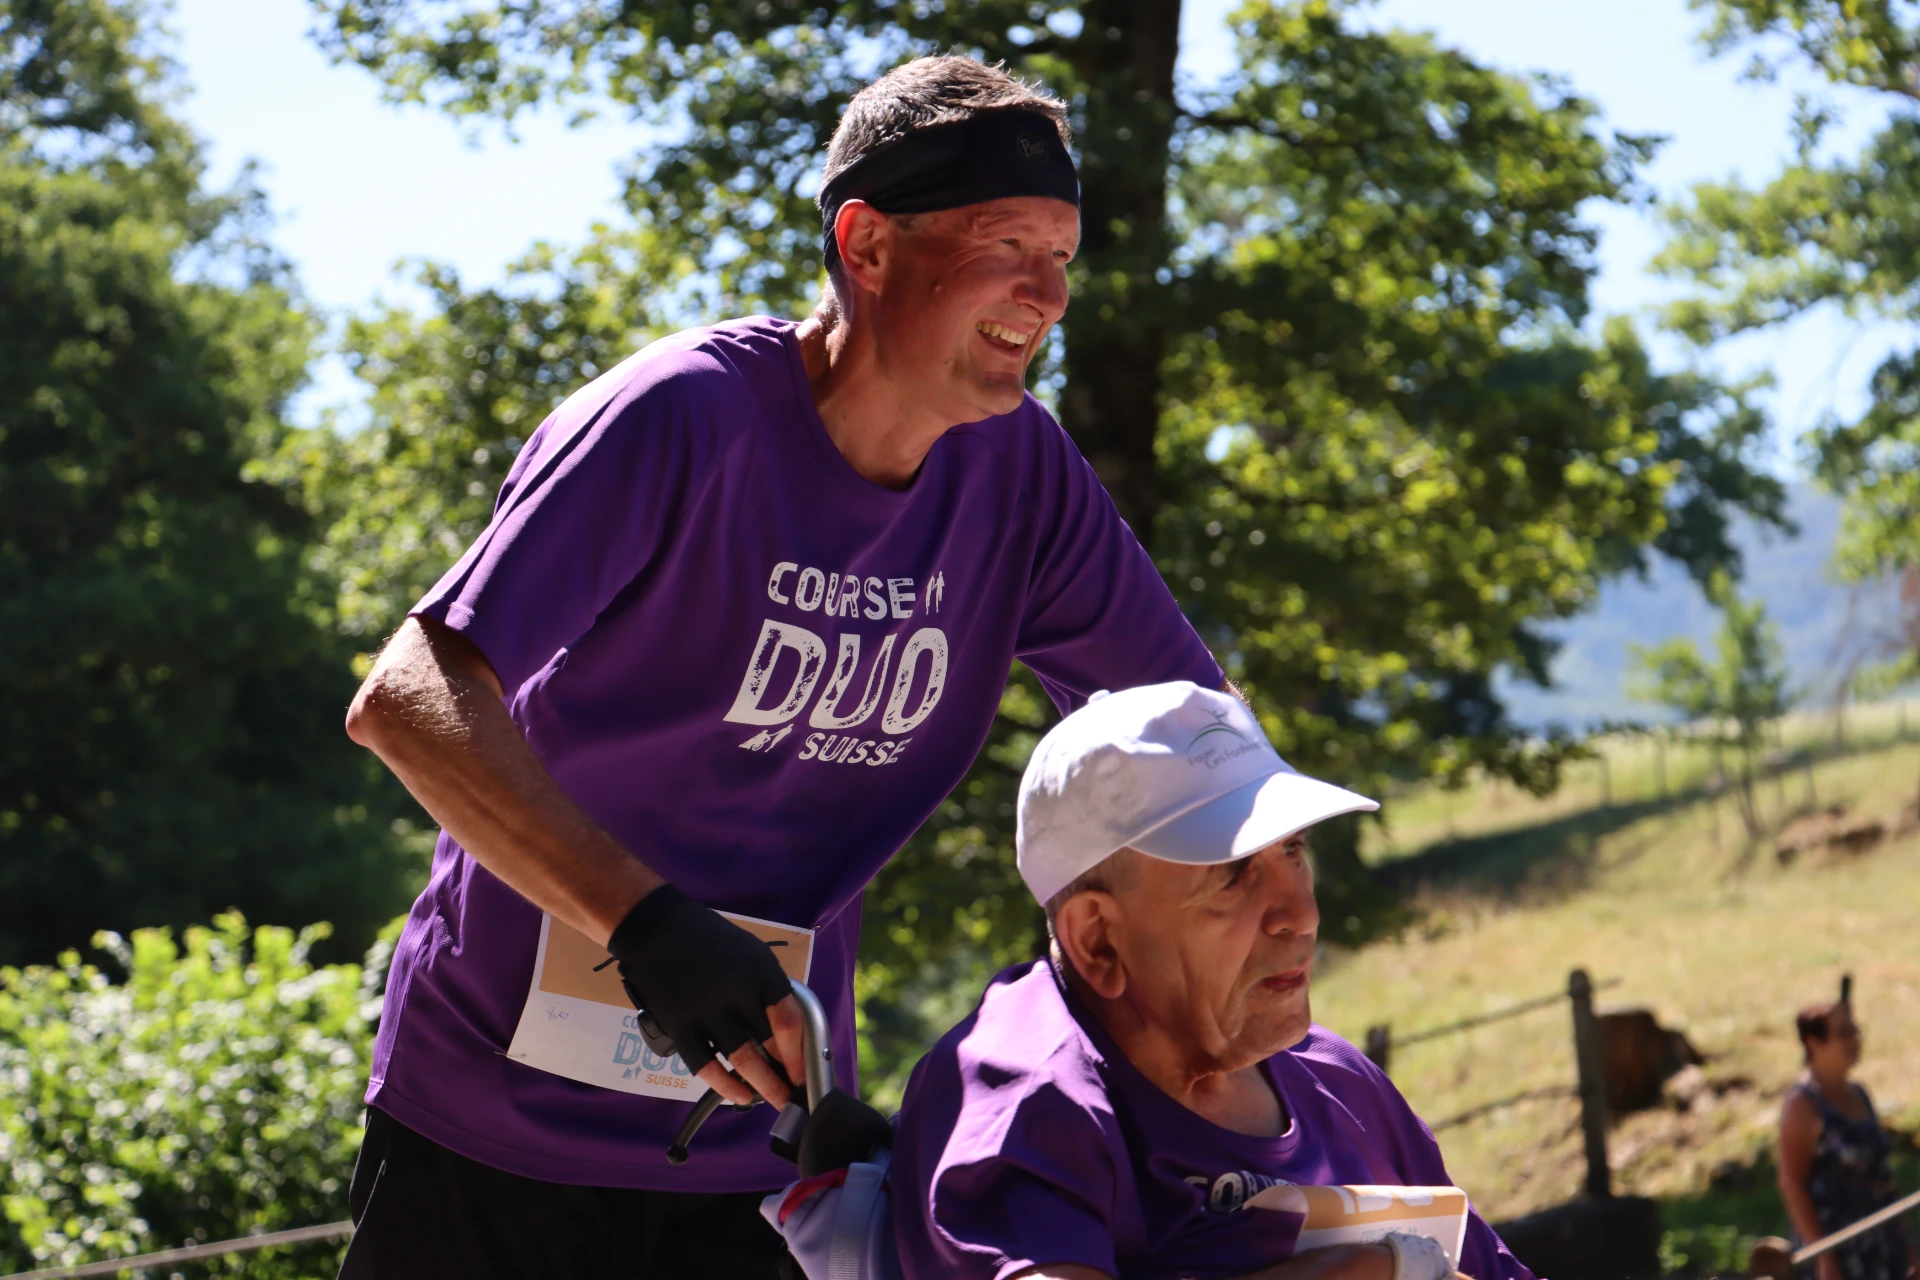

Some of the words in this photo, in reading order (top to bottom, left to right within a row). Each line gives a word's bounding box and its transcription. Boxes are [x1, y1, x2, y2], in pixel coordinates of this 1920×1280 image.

[767, 561, 916, 620] COURSE
[723, 618, 949, 735] DUO
[798, 732, 913, 766] SUISSE
[645, 1073, 689, 1089] SUISSE
